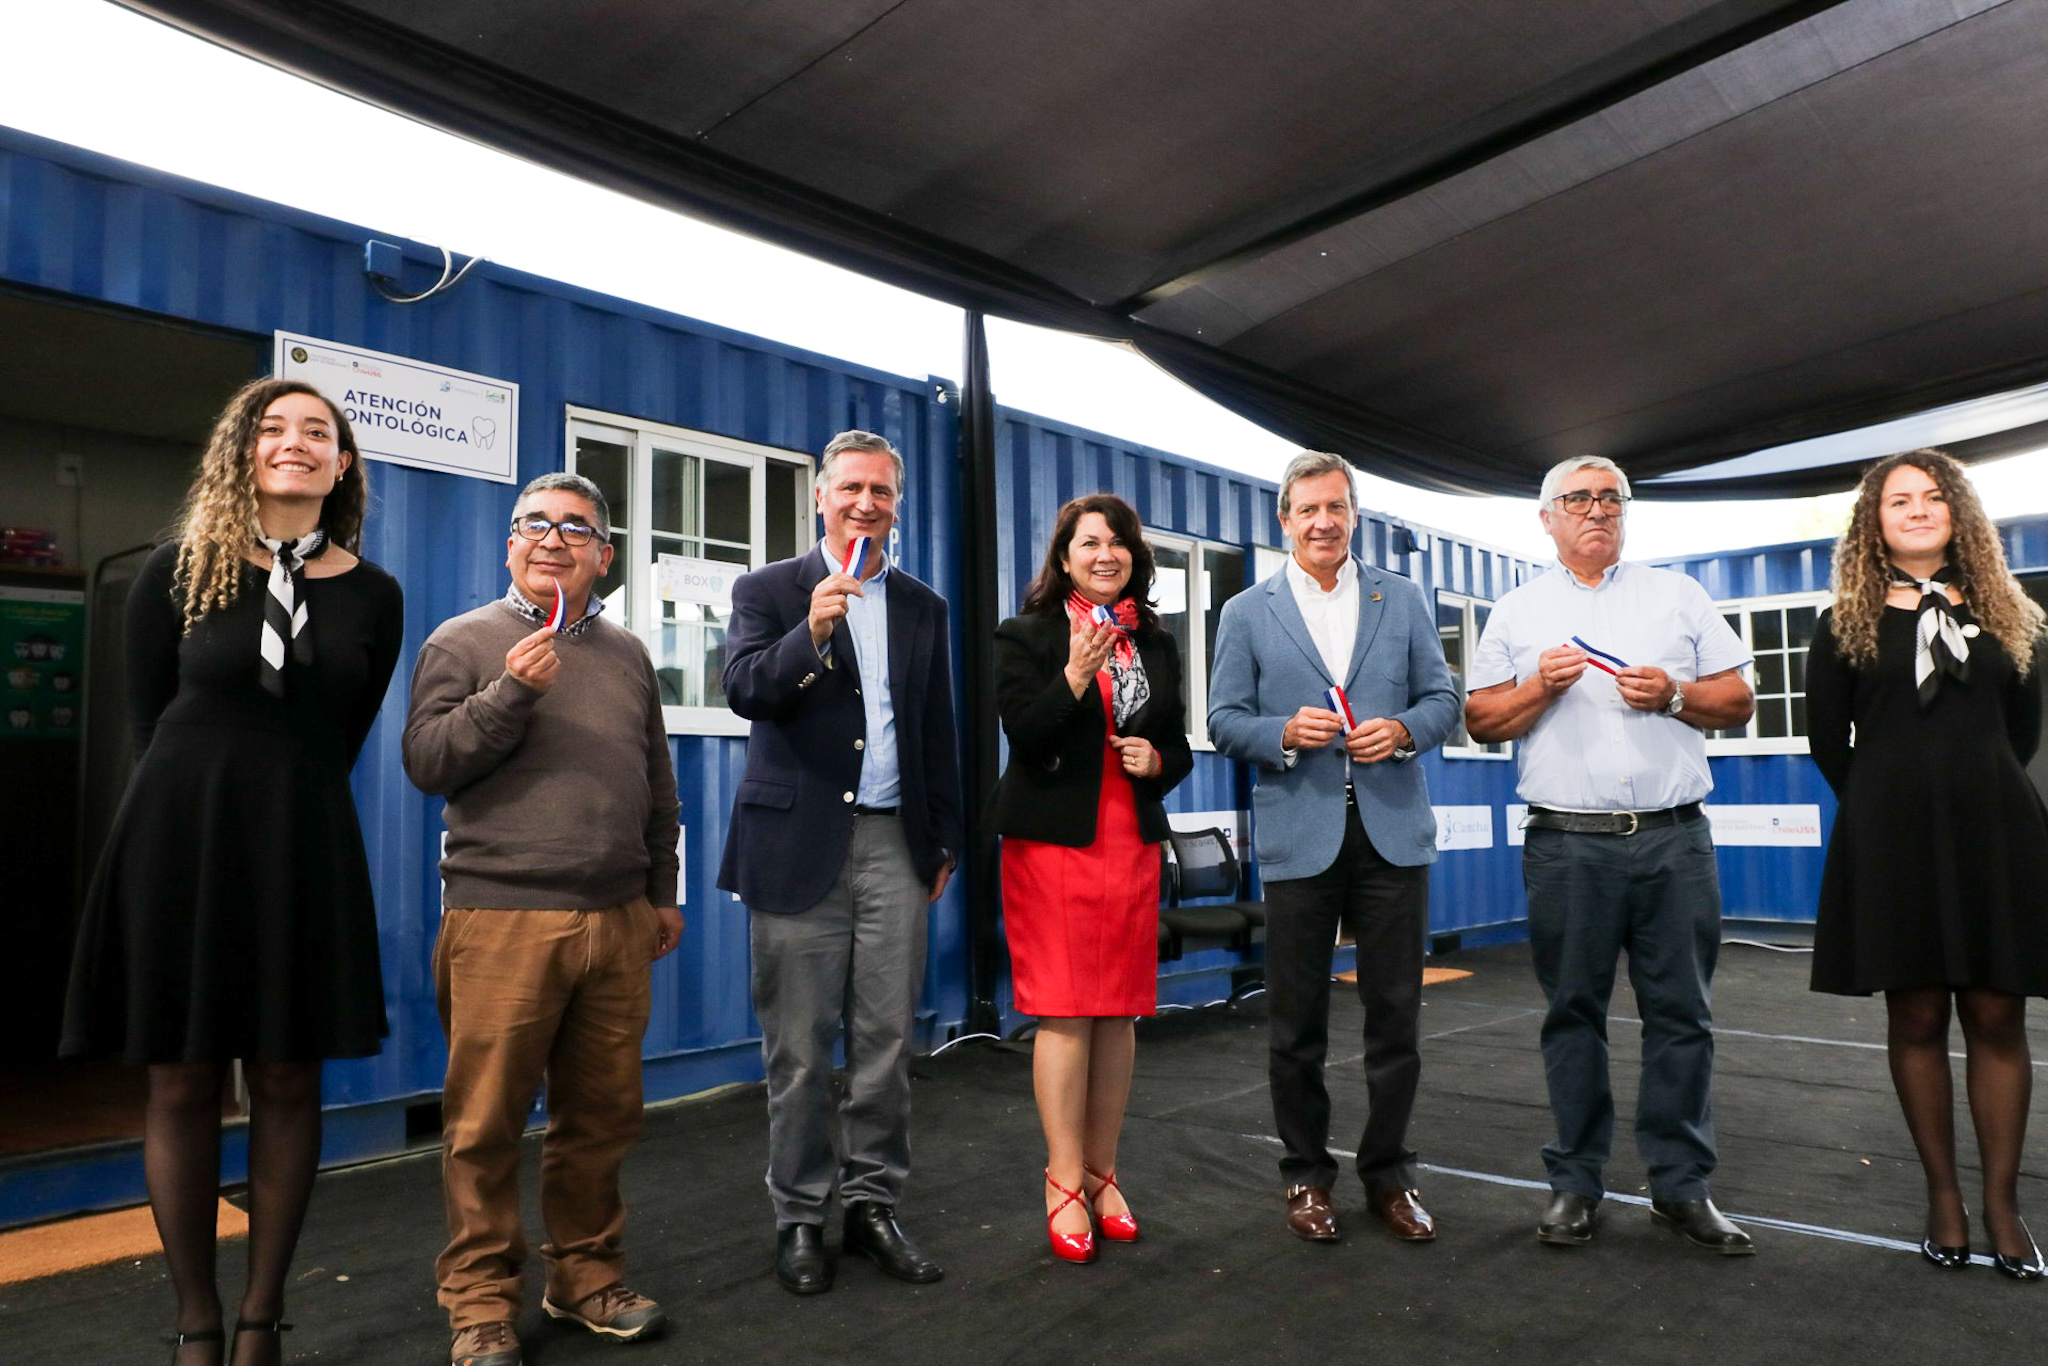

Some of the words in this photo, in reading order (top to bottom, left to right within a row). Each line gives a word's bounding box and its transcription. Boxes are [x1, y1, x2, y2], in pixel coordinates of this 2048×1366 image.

[344, 389, 442, 420] ATENCIÓN
[346, 408, 469, 444] ONTOLÓGICA
[684, 574, 709, 588] BOX
